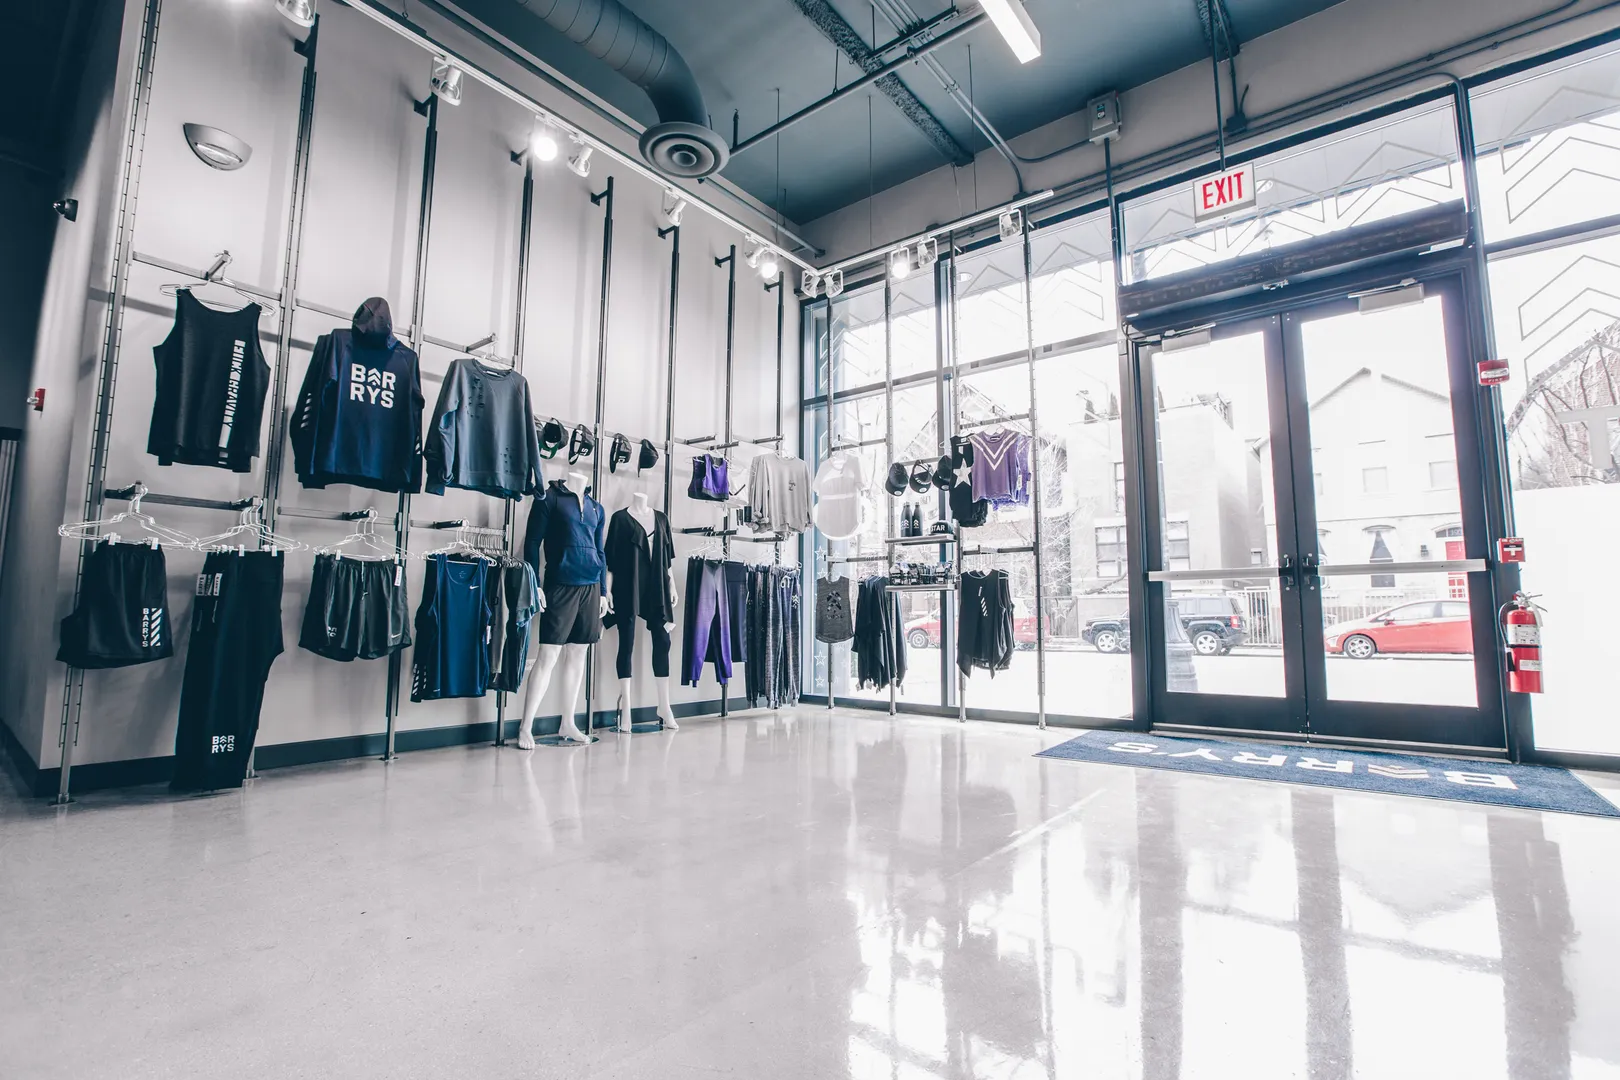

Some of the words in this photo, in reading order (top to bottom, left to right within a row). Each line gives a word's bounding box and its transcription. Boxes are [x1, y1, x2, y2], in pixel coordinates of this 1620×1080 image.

[1202, 171, 1244, 210] EXIT
[350, 382, 395, 408] RYS
[142, 607, 150, 648] BARRYS
[211, 743, 235, 754] RYS
